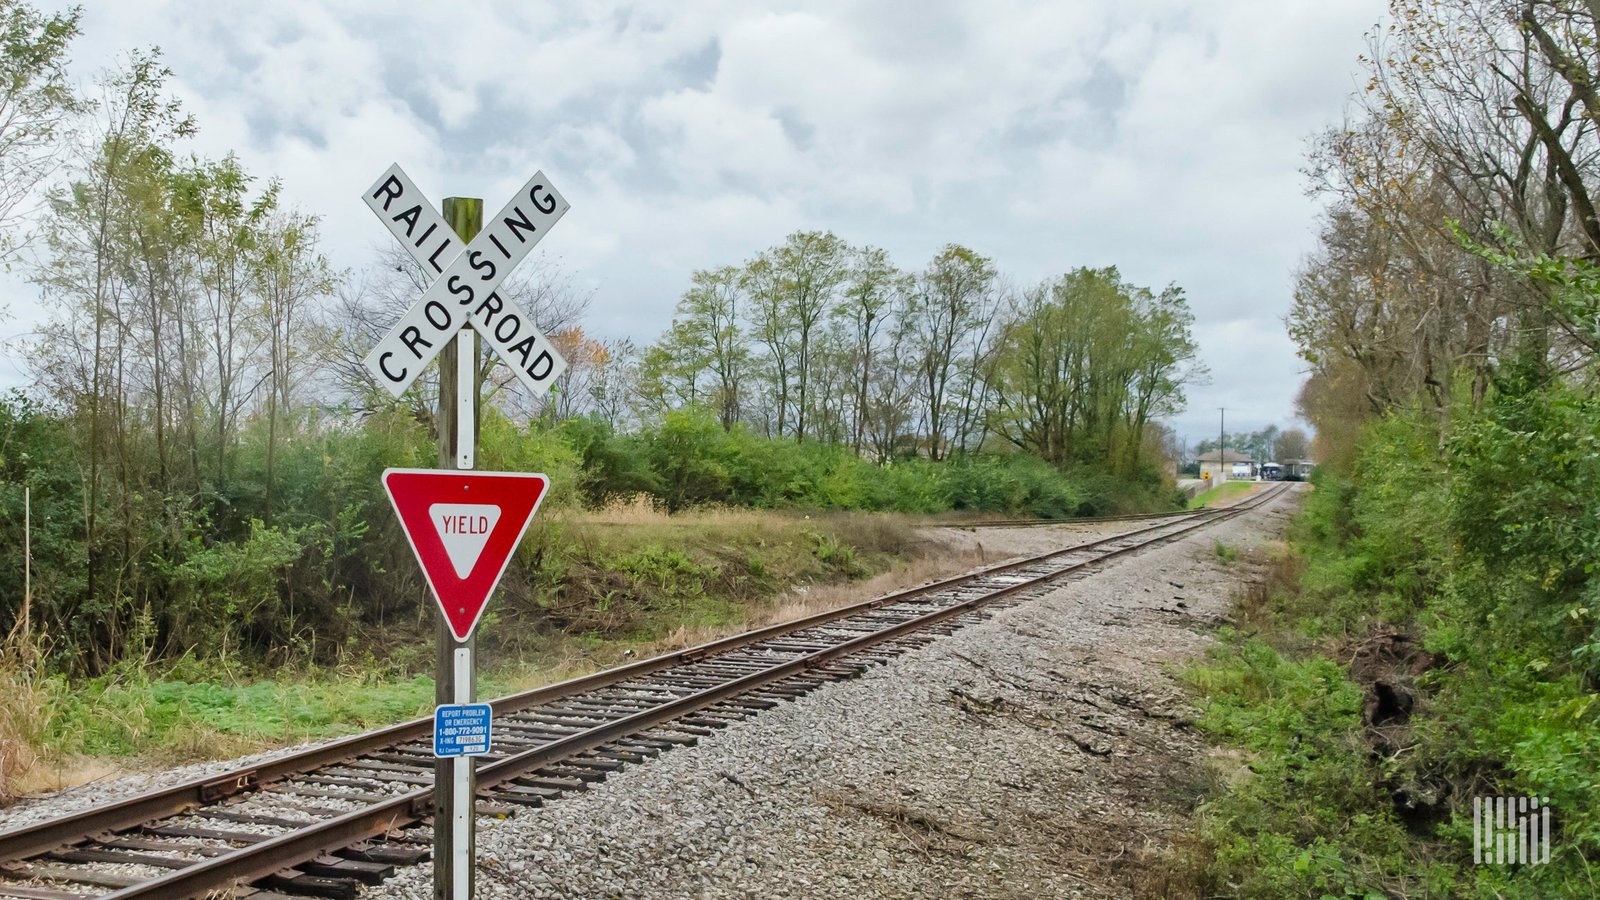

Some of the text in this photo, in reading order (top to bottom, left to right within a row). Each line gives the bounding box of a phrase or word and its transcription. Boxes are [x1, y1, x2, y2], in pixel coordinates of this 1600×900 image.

[372, 174, 554, 382] RAIL ROAD
[379, 184, 557, 383] CROSSING
[442, 515, 488, 534] YIELD
[442, 709, 486, 718] REPORT PROBLEM
[445, 718, 483, 727] OR EMERGENCY
[439, 726, 487, 736] 1-800-772-9091
